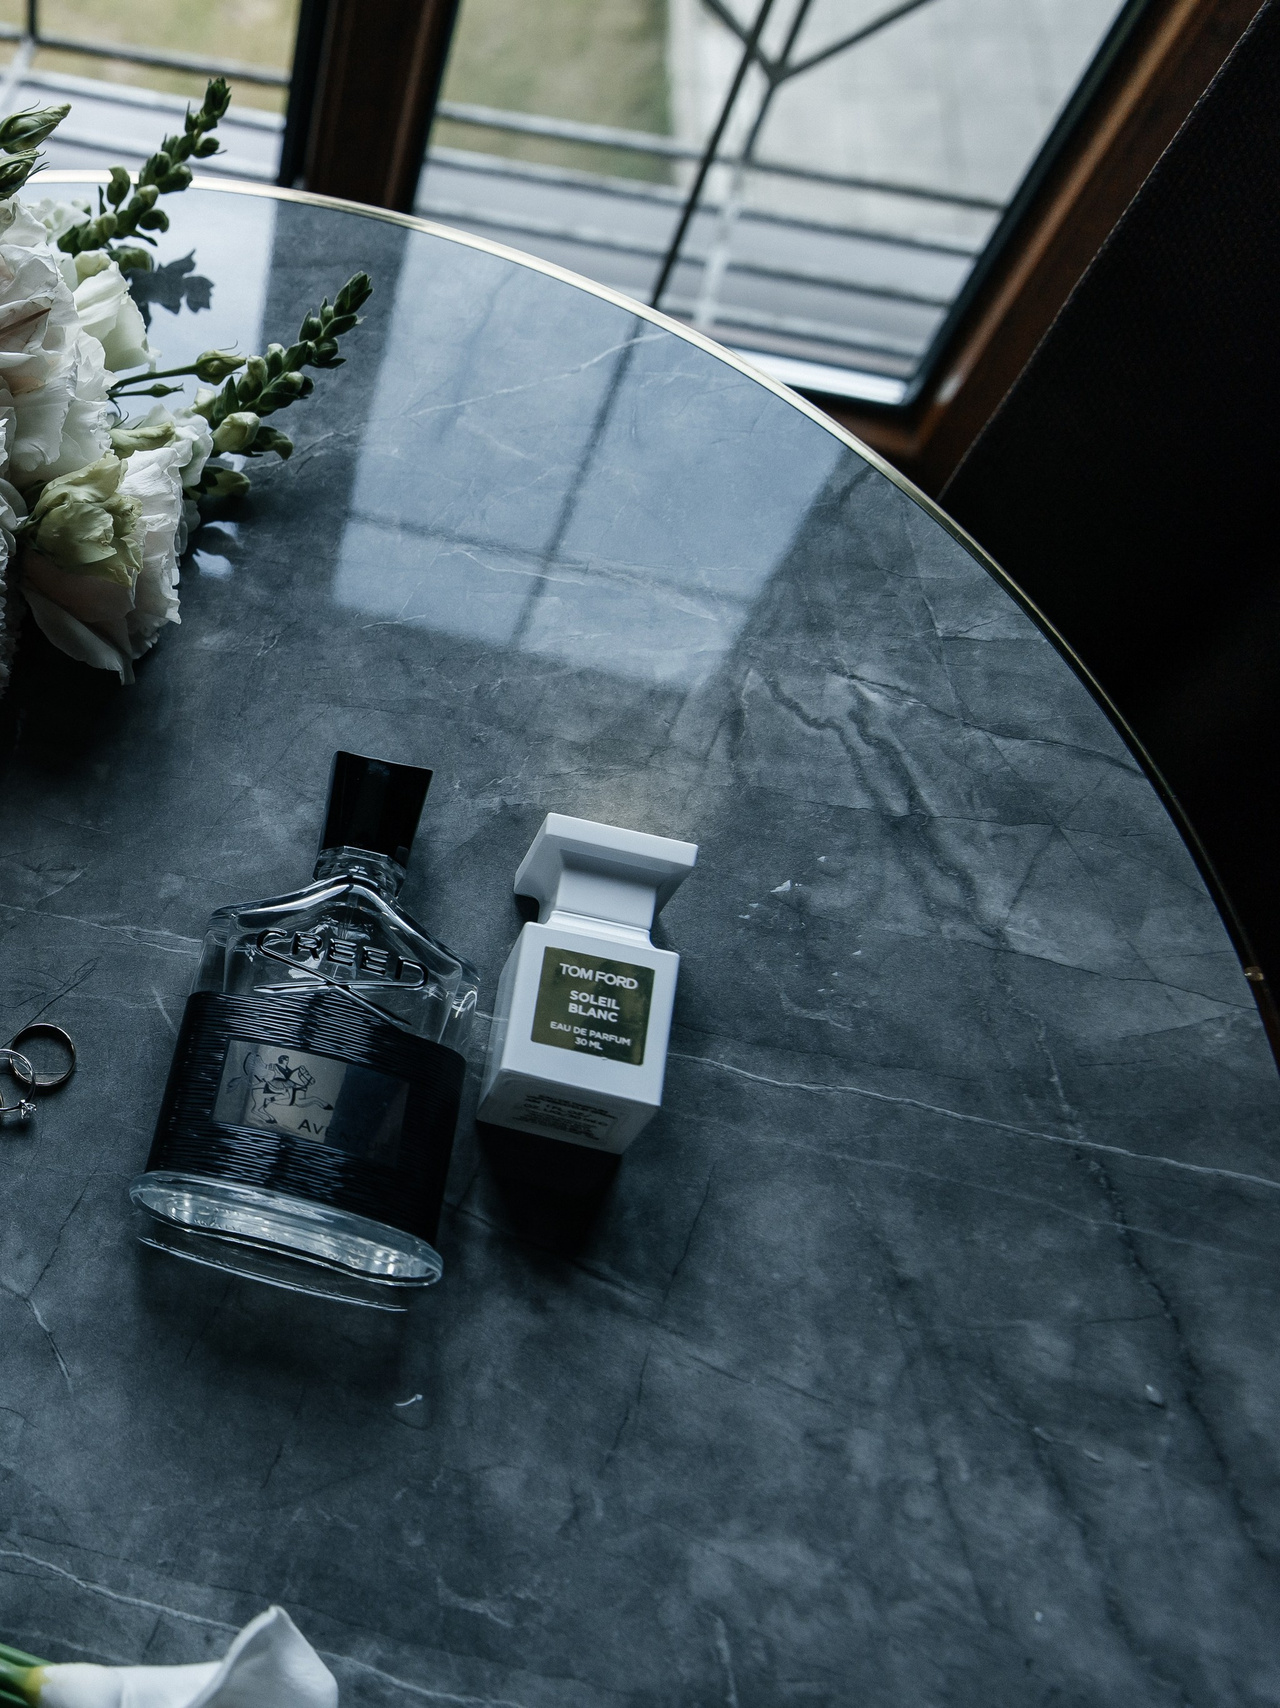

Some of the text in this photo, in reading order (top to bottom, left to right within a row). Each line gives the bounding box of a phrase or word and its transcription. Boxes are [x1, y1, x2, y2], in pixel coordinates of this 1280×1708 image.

[255, 926, 430, 992] CREED
[559, 963, 639, 990] TOM FORD
[569, 990, 620, 1010] SOLEIL
[568, 1002, 619, 1023] BLANC
[550, 1021, 631, 1046] EAU DE PARFUM
[575, 1036, 603, 1051] 30 ML
